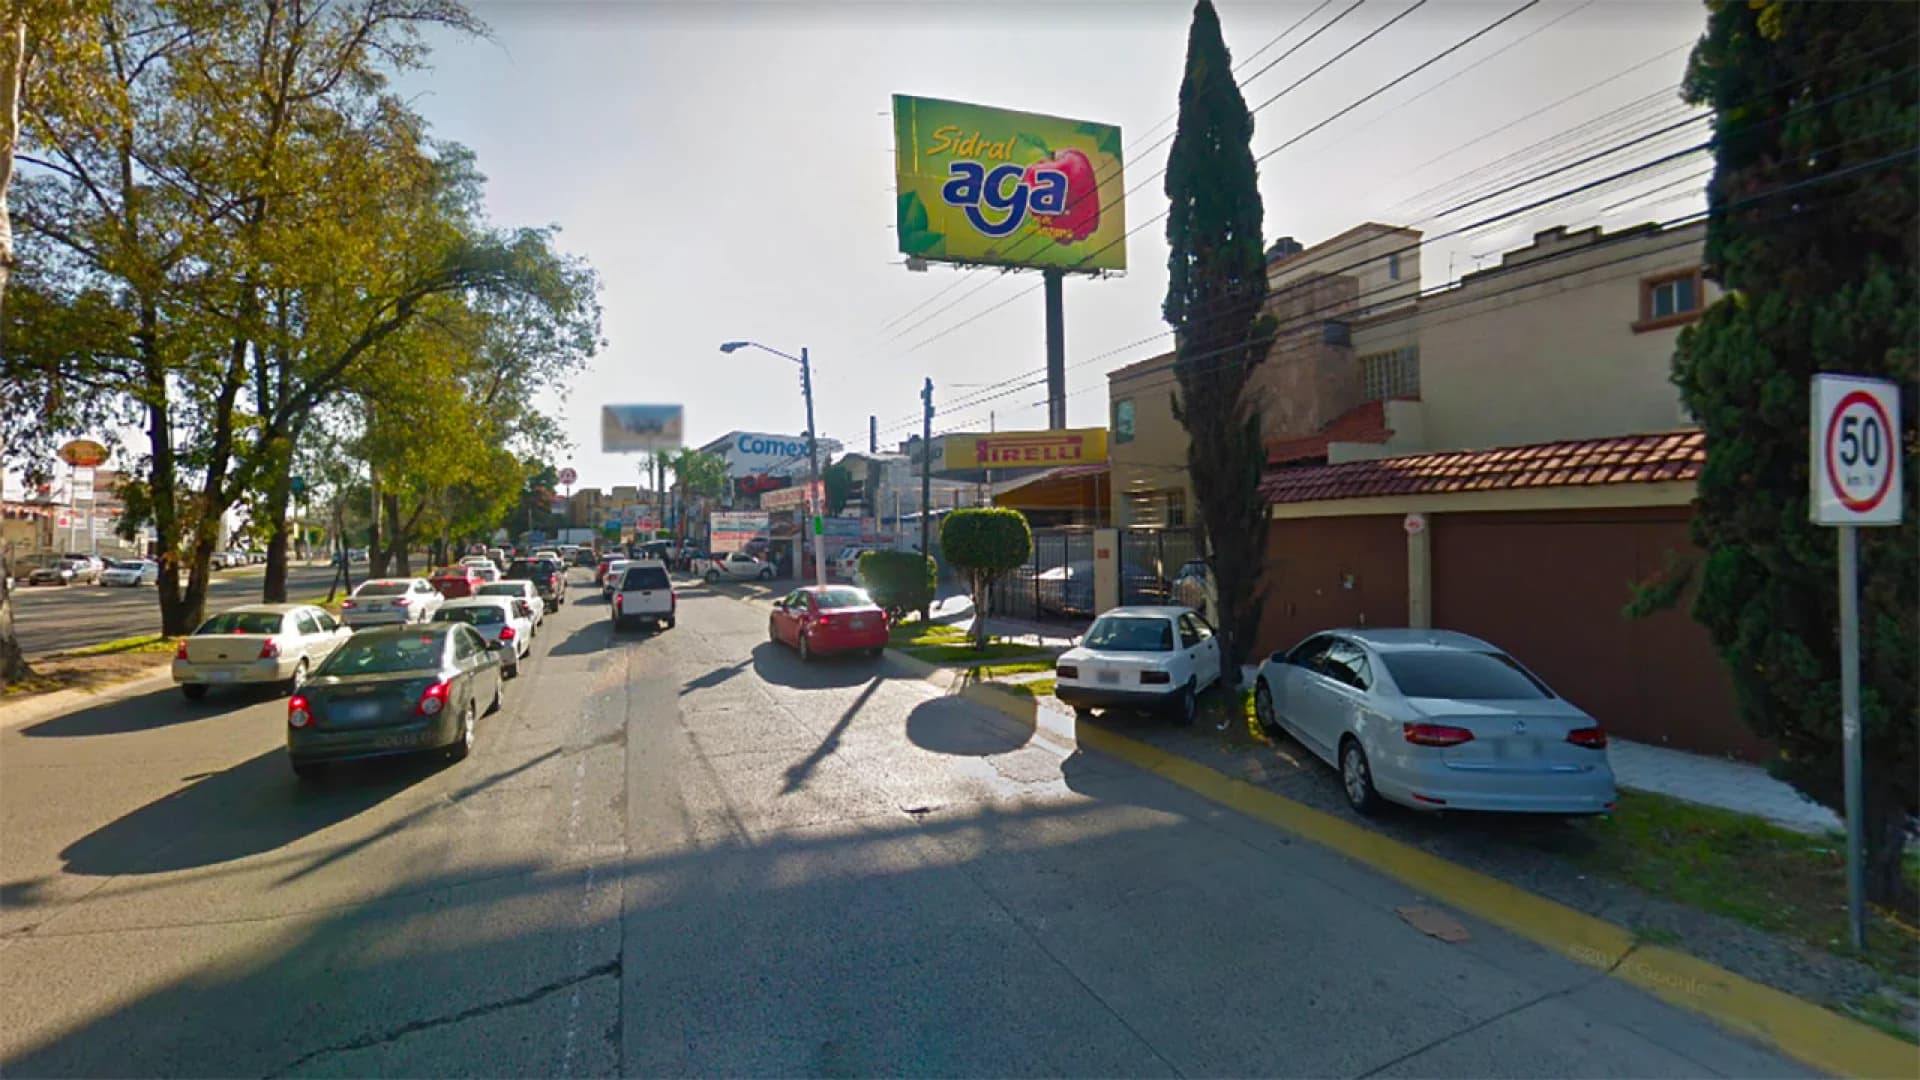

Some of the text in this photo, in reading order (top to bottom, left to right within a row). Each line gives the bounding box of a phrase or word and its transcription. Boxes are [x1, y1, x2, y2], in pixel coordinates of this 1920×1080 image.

[927, 126, 1018, 160] Sidral
[942, 161, 1068, 237] aga
[738, 433, 811, 457] Comex
[976, 435, 1083, 462] PIRELLI
[1839, 416, 1880, 466] 50
